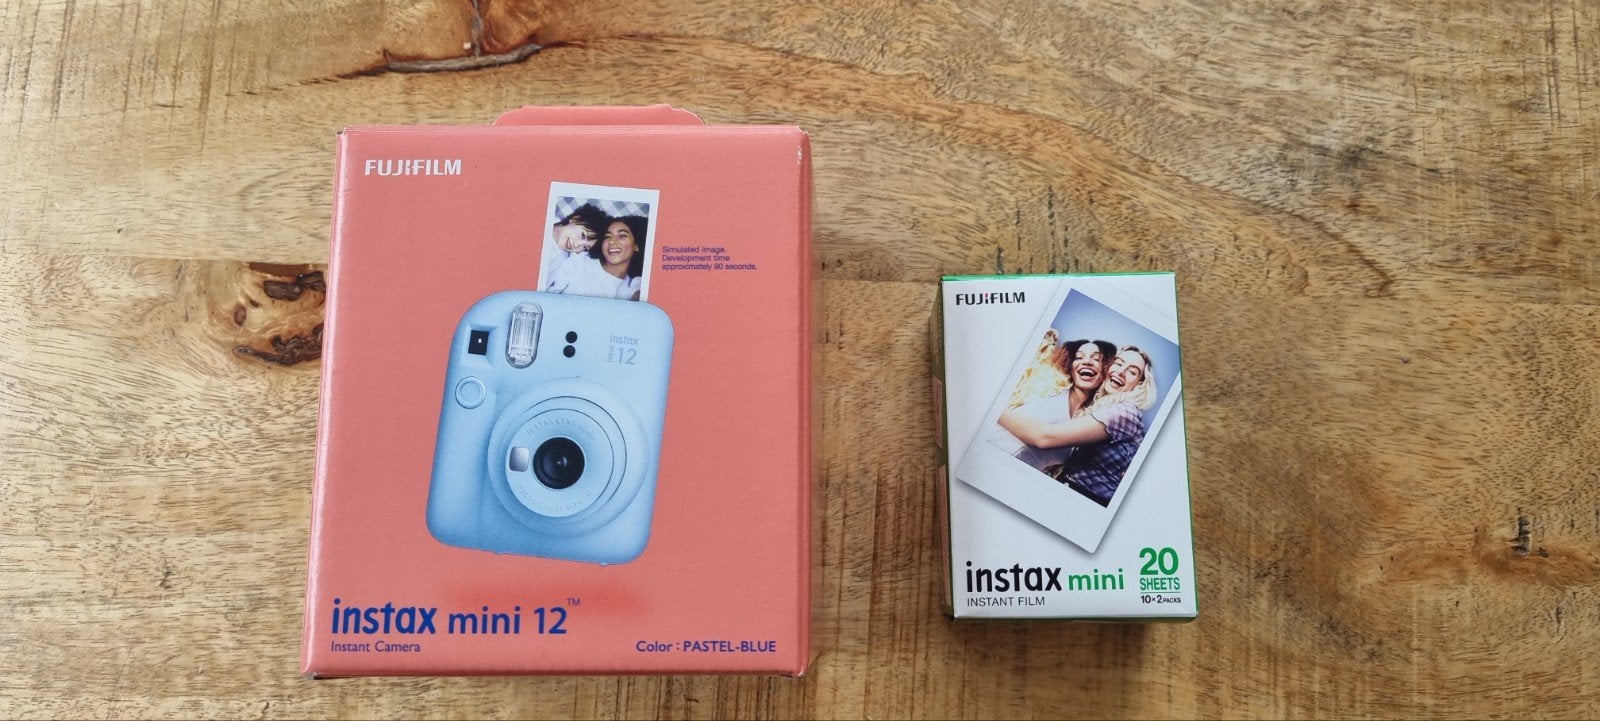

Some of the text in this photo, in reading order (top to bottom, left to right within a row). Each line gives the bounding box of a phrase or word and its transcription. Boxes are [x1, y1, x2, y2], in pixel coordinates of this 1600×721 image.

[364, 159, 462, 176] FUJIFILM
[662, 245, 727, 254] Simulated image.
[661, 254, 712, 262] Development
[661, 263, 712, 271] approximately
[713, 262, 724, 270] 90
[955, 292, 1026, 306] FUJIFILM
[609, 333, 639, 345] instax
[617, 347, 637, 365] 12
[1139, 547, 1179, 576] 20
[965, 560, 1124, 593] instax mini
[1139, 577, 1181, 591] SHEETS
[967, 596, 1046, 607] INSTANT FILM
[331, 597, 438, 635] instax
[448, 605, 521, 635] mini
[533, 606, 568, 635] 12
[330, 640, 422, 653] Instant Camera
[683, 640, 777, 653] PASTEL-BLUE
